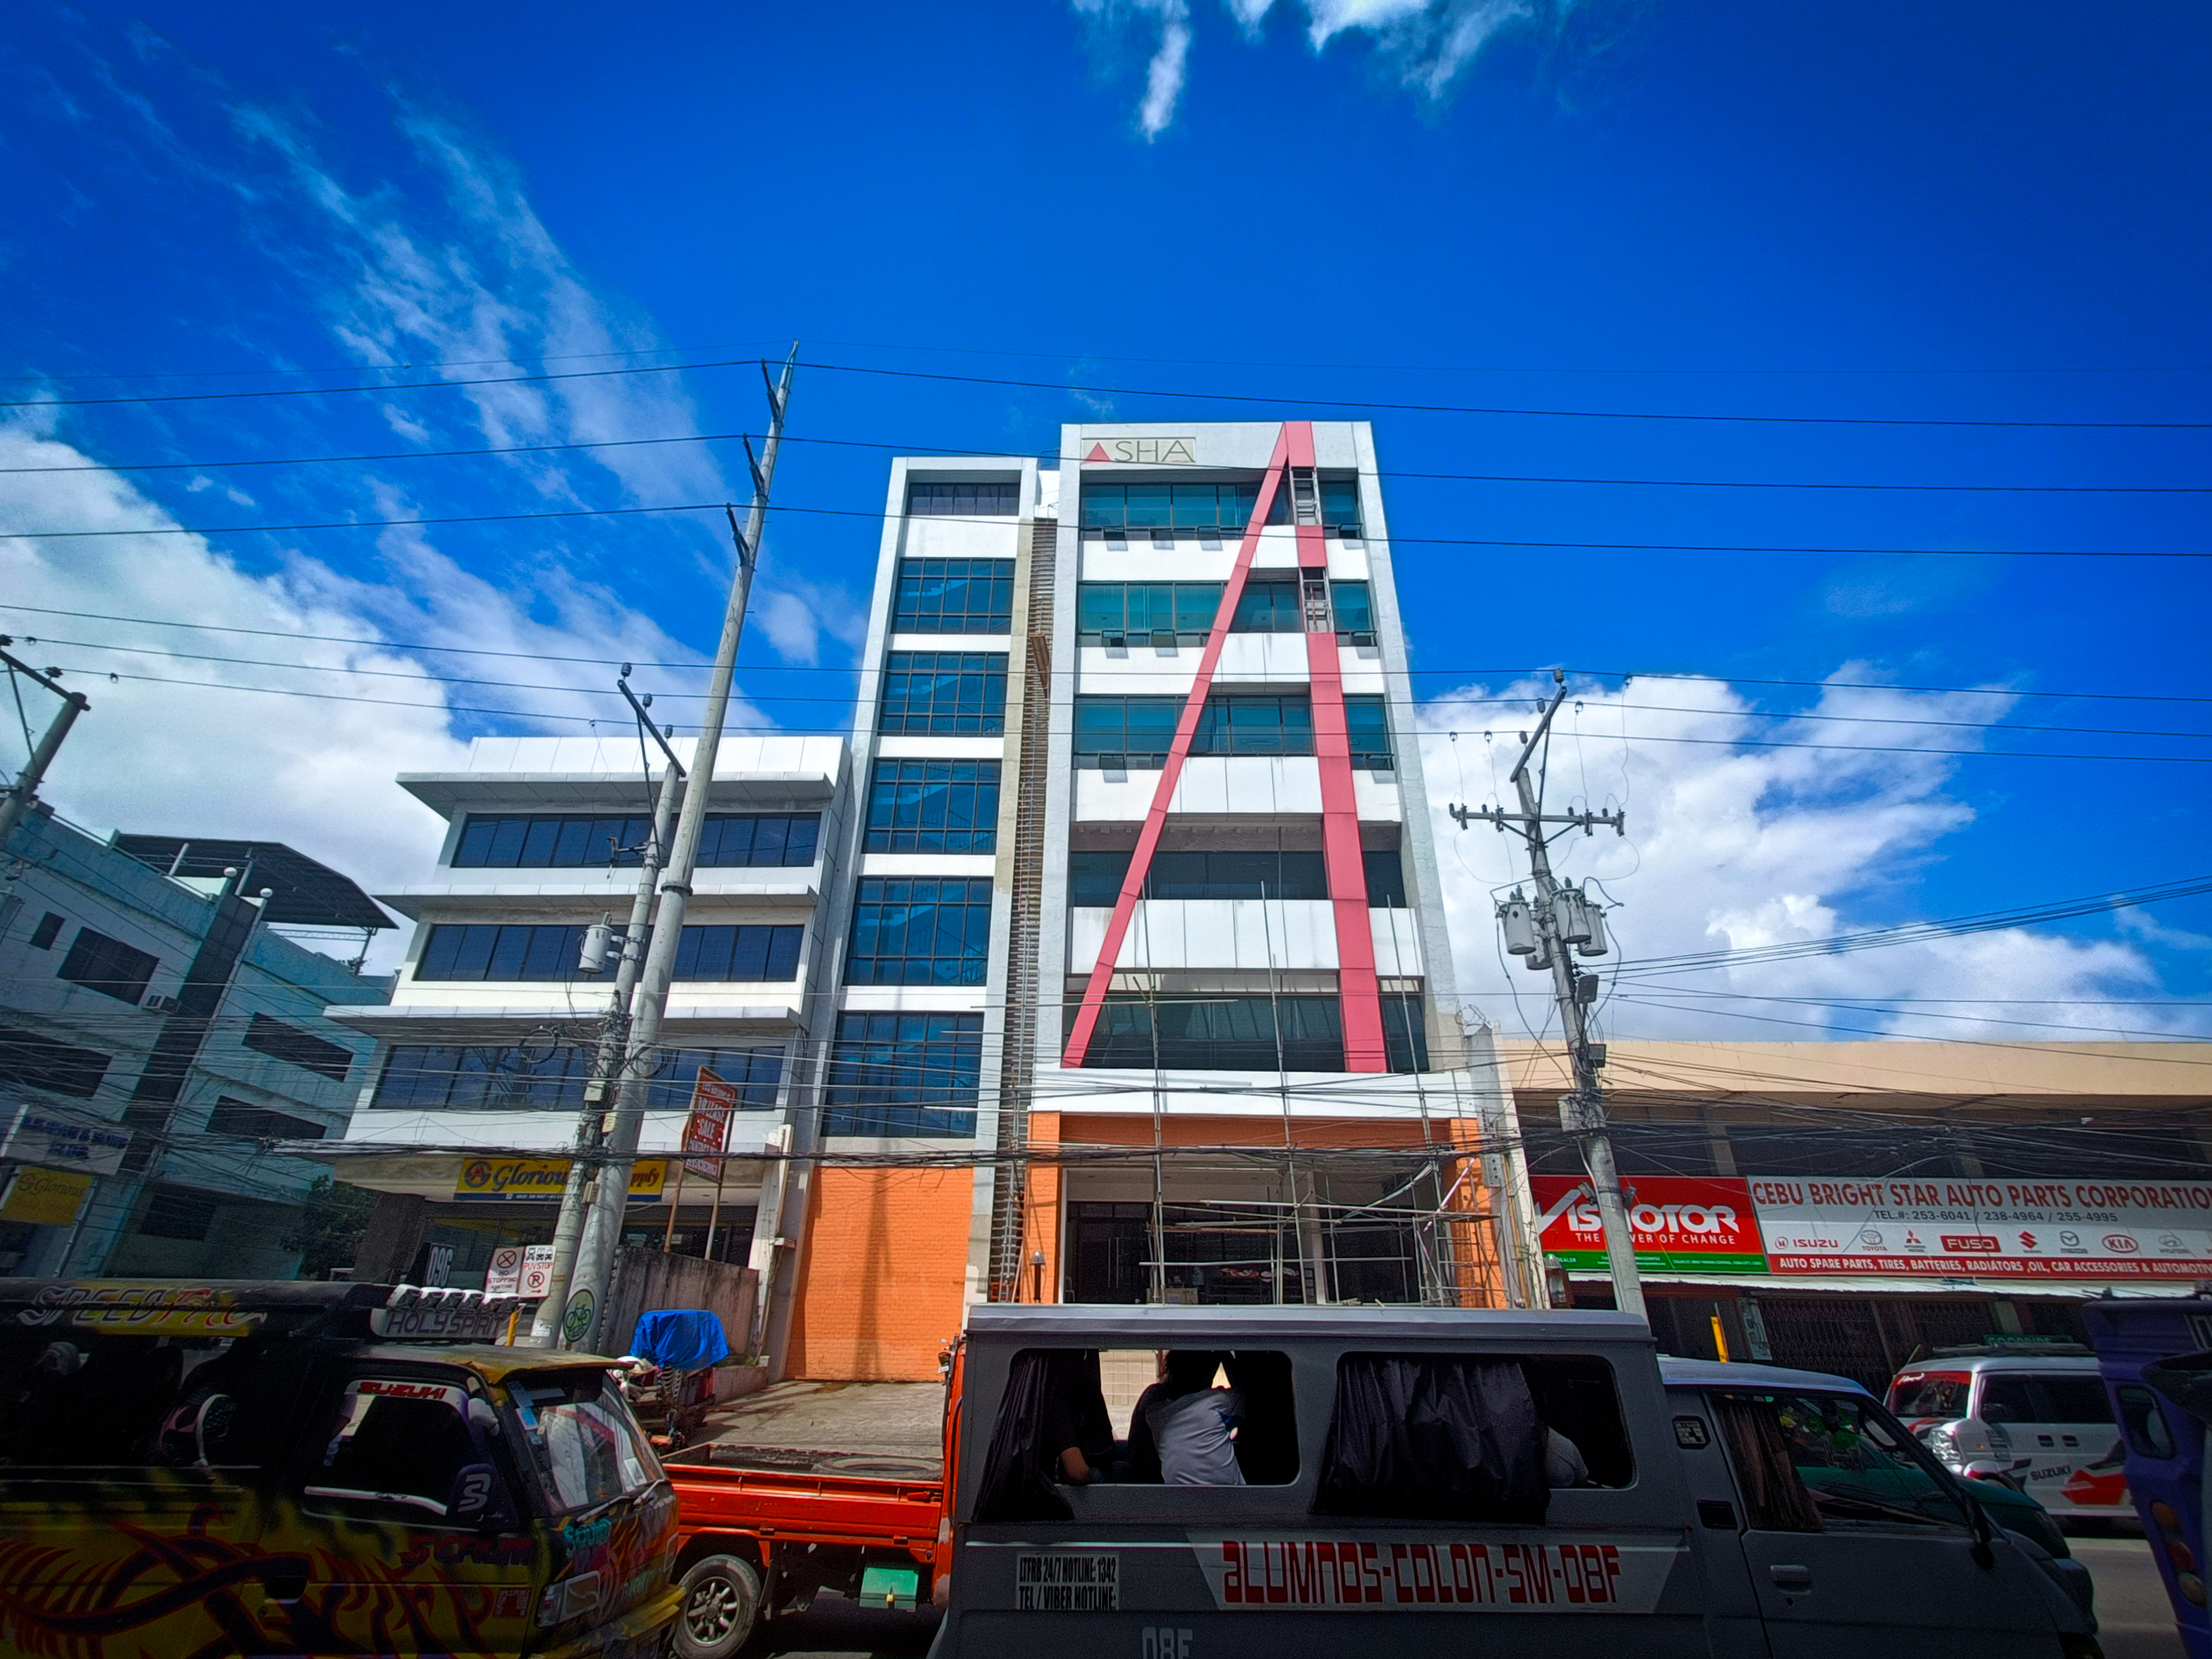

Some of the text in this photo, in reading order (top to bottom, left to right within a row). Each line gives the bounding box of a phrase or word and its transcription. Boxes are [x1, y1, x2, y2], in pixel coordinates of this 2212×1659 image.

[698, 1118, 716, 1140] SALE
[33, 1176, 87, 1196] Glorious
[492, 1162, 567, 1192] Gloriou
[1753, 1182, 1803, 1205] CEBU
[1808, 1184, 1886, 1206] BRIGHT
[1890, 1184, 1943, 1207] STAR
[1948, 1184, 2003, 1207] AUTO
[2006, 1185, 2072, 1207] PARTS
[1873, 1210, 1909, 1220] TEL.#:
[1912, 1211, 1971, 1220] 253-6041
[1984, 1212, 2044, 1221] 238-4964
[2056, 1212, 2118, 1222] 255-4995
[1576, 1233, 1600, 1242] THE
[1660, 1233, 1675, 1244] OF
[1681, 1235, 1736, 1245] CHANGE
[1793, 1239, 1839, 1248] ISUZU
[1947, 1238, 1995, 1249] FUSO
[2109, 1238, 2132, 1248] KIA
[426, 1246, 453, 1287] 096
[1780, 1258, 1807, 1269] AUTO
[1810, 1259, 1840, 1269] SPARE
[1843, 1259, 1877, 1270] PARTS,
[1878, 1259, 1908, 1270] TIRES,
[1911, 1259, 1965, 1272] BATTERIES,
[1967, 1260, 2023, 1272] RADIATORS
[2052, 1261, 2071, 1272] CAR
[2074, 1262, 2140, 1273] ACCESSORIES
[2141, 1263, 2151, 1273] &
[386, 1312, 506, 1336] HOLY SPIRIT
[357, 1381, 447, 1399] SUZUKI
[2030, 1465, 2071, 1480] SUZUKI
[1020, 1557, 1116, 1582] LTFRB 24/7 HOTLINE: 1342
[1019, 1586, 1034, 1609] TEL
[1044, 1586, 1072, 1609] VIBER
[1074, 1586, 1116, 1610] HOTLINE:
